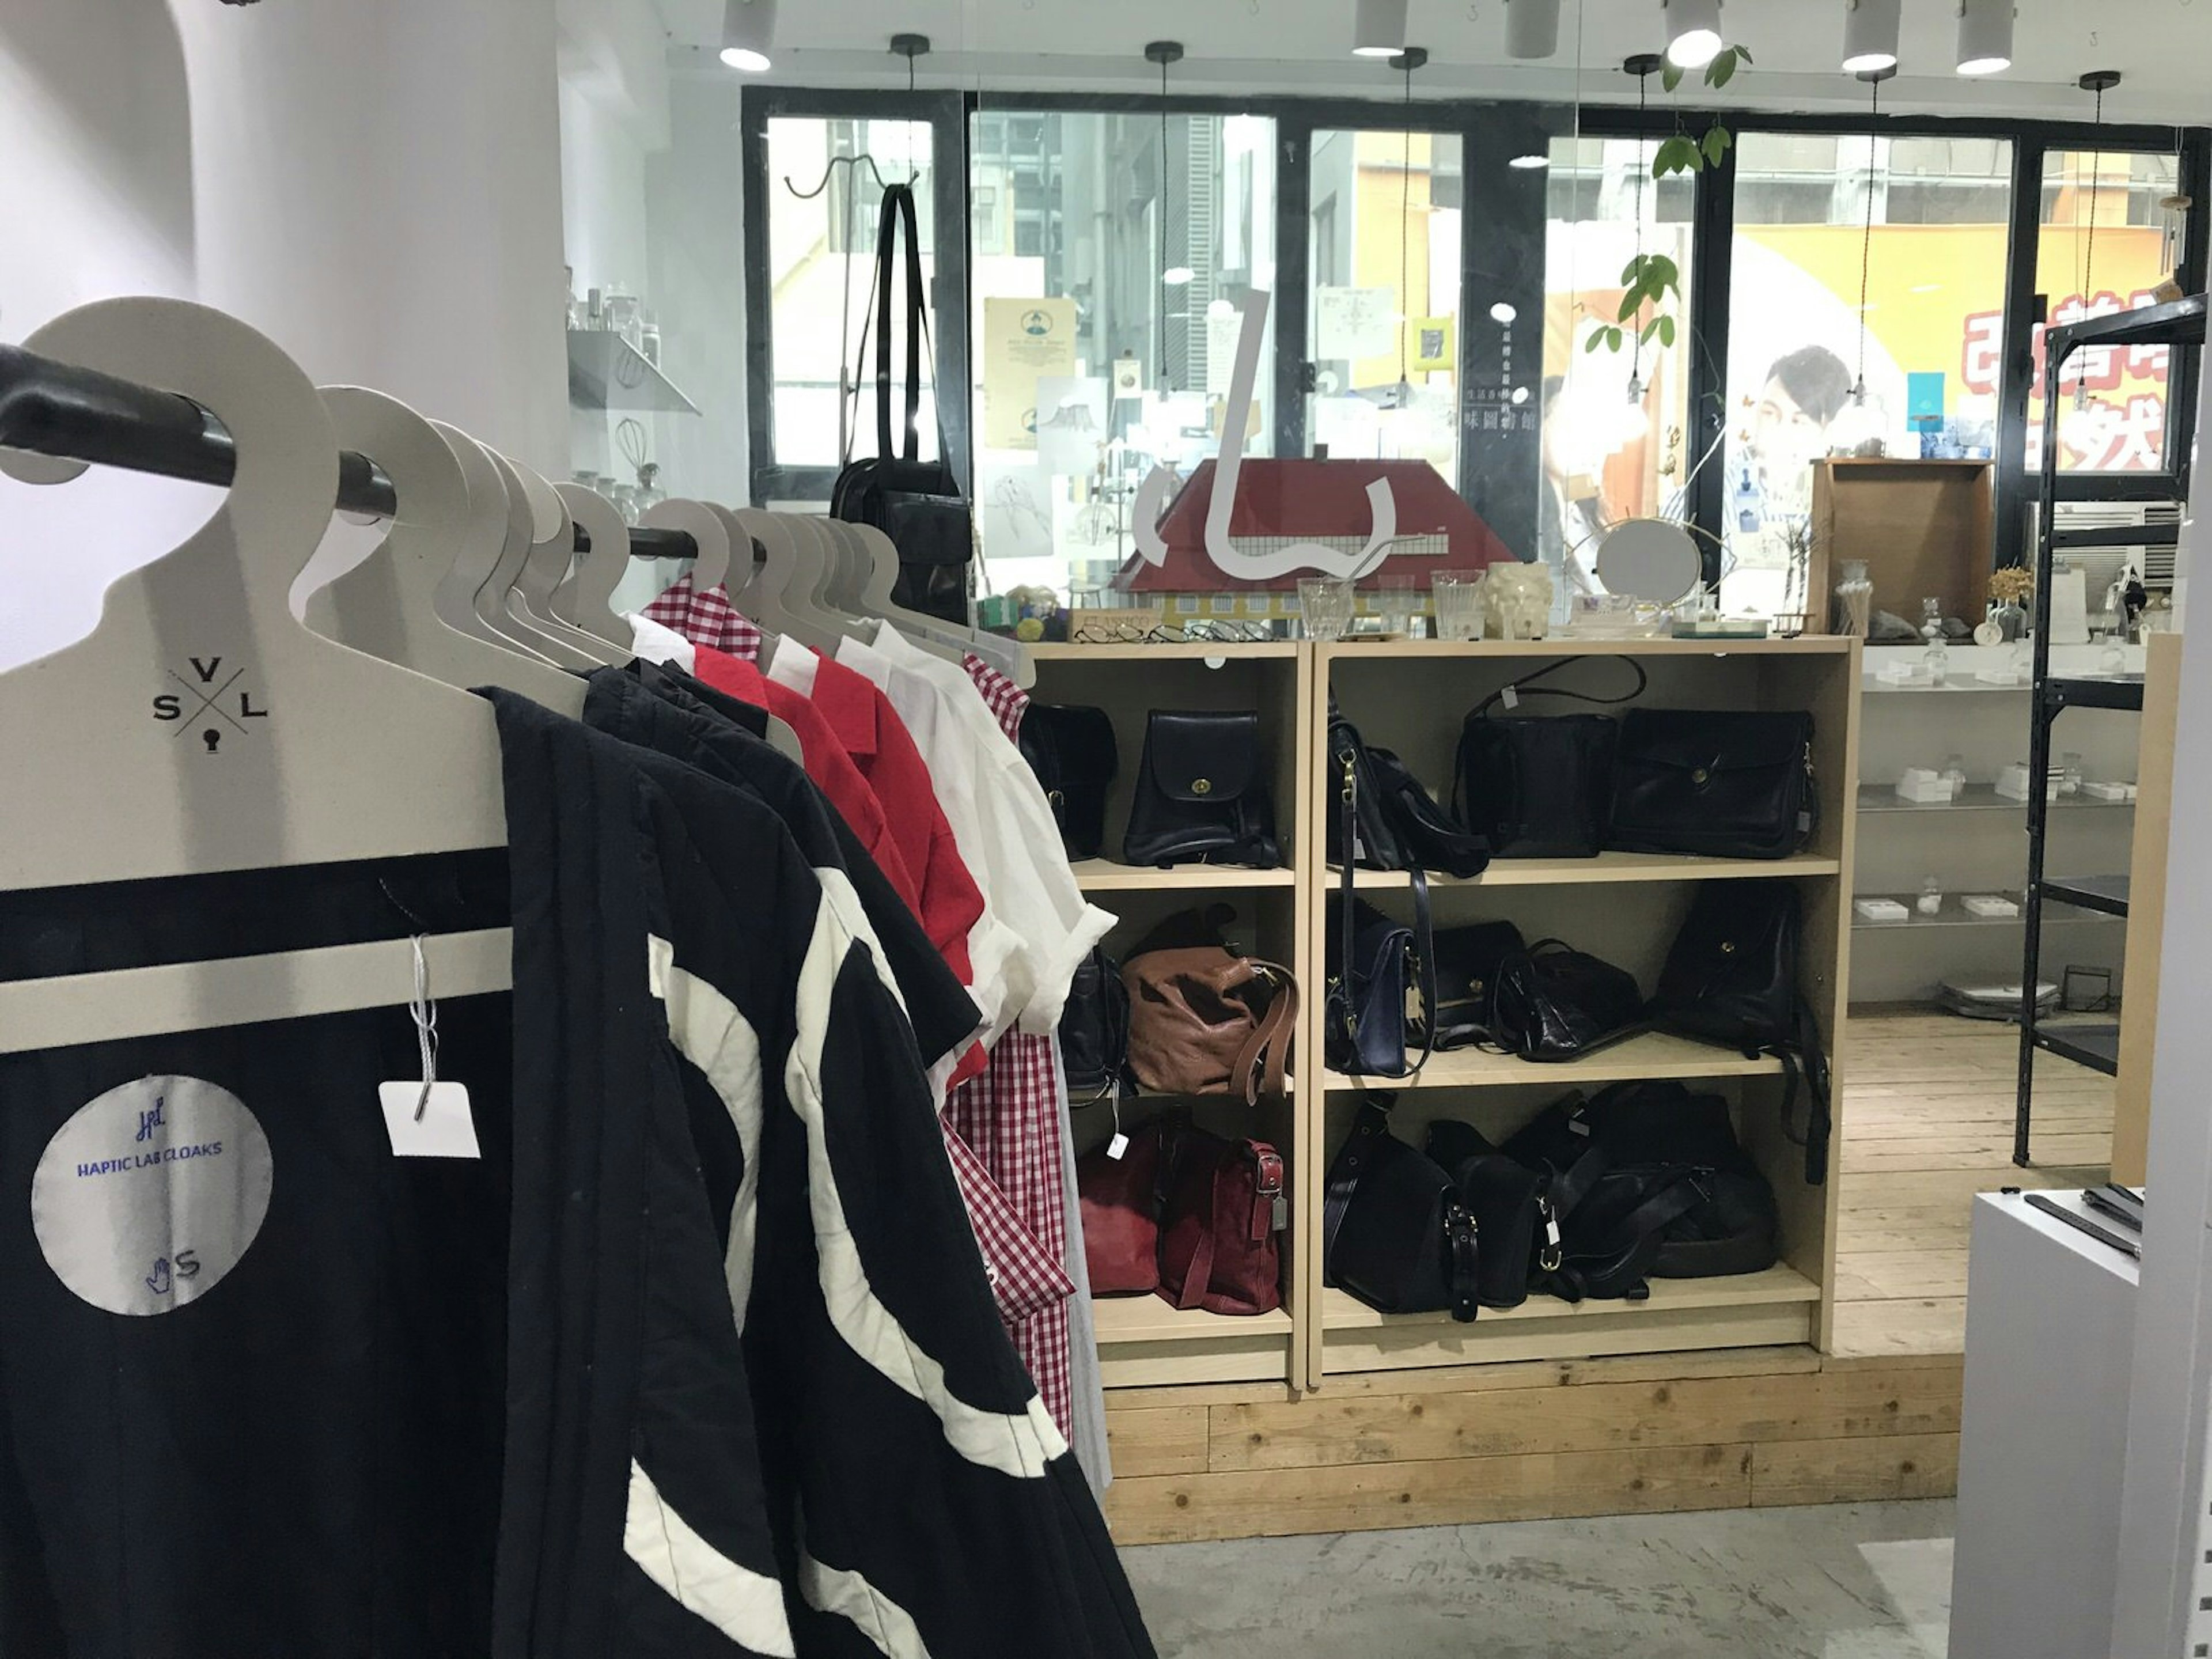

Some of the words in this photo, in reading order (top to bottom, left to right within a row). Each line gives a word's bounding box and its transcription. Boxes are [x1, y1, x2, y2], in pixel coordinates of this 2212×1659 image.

[188, 657, 222, 682] V
[153, 695, 180, 720] S
[240, 692, 268, 717] L
[77, 1157, 131, 1177] HAPTIC
[135, 1152, 160, 1168] LAB
[164, 1141, 222, 1162] CLOAKS
